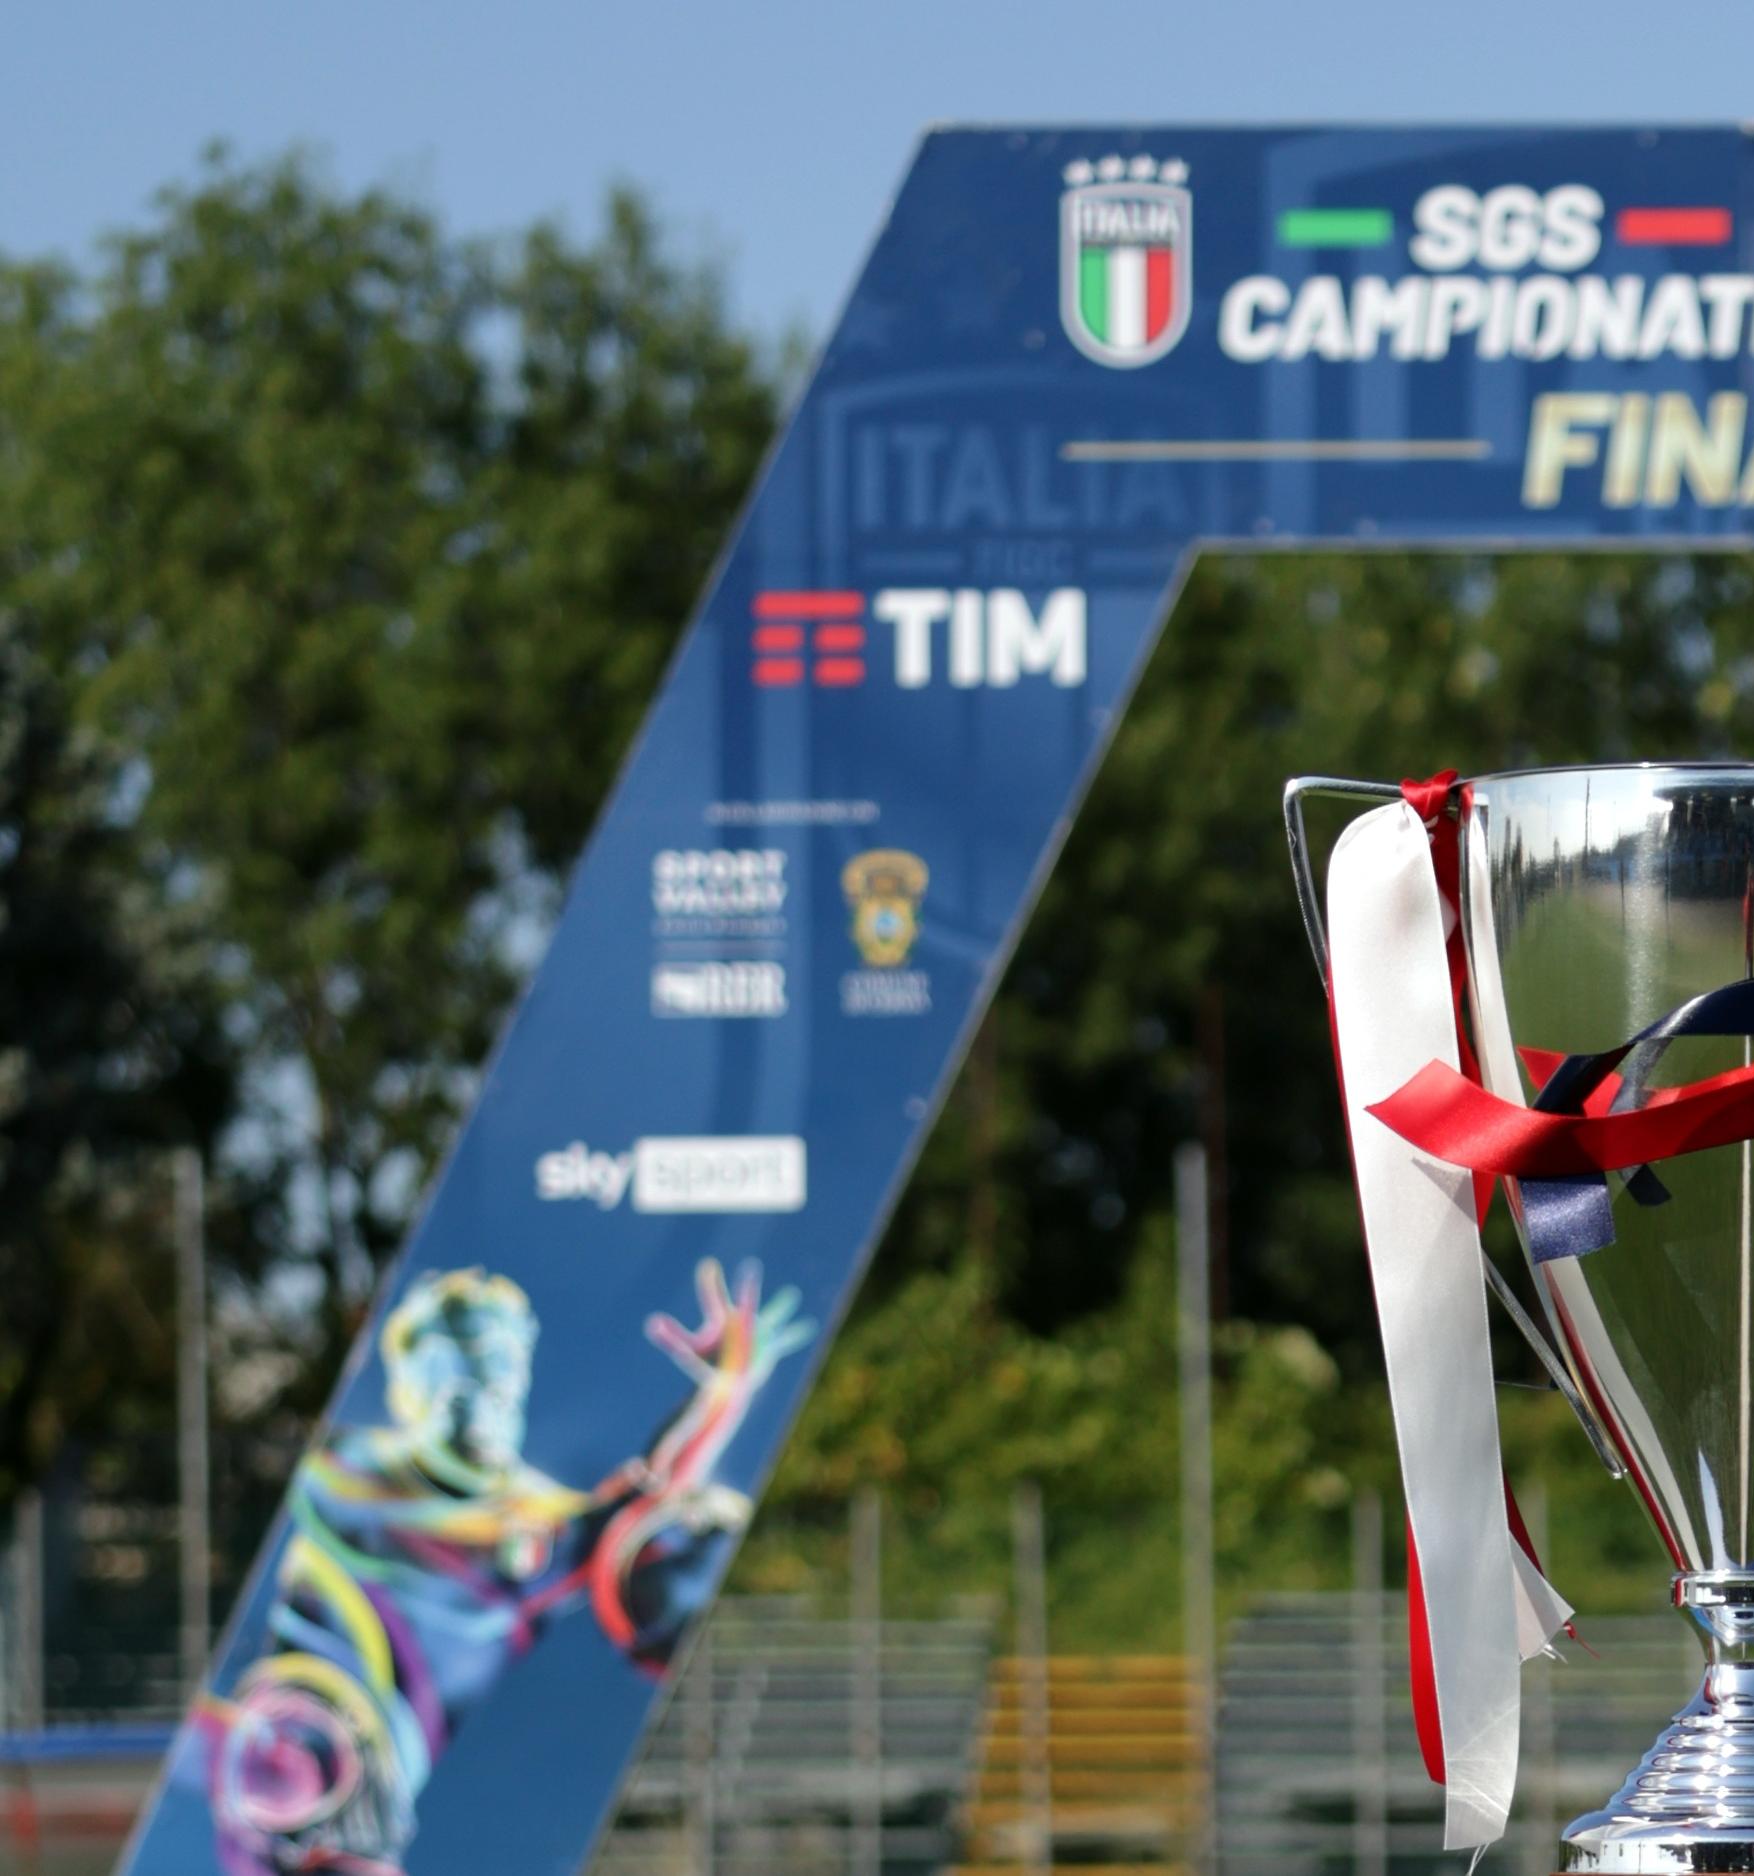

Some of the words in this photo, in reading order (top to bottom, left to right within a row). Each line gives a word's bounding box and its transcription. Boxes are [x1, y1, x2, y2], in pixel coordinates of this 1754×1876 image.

[1080, 202, 1182, 238] ITALIA
[1409, 184, 1602, 271] SGS
[874, 587, 1087, 689] TIM
[653, 849, 786, 881] SPORT
[653, 880, 786, 914] VALLEY
[535, 1140, 634, 1212] sky
[653, 1150, 783, 1197] sport
